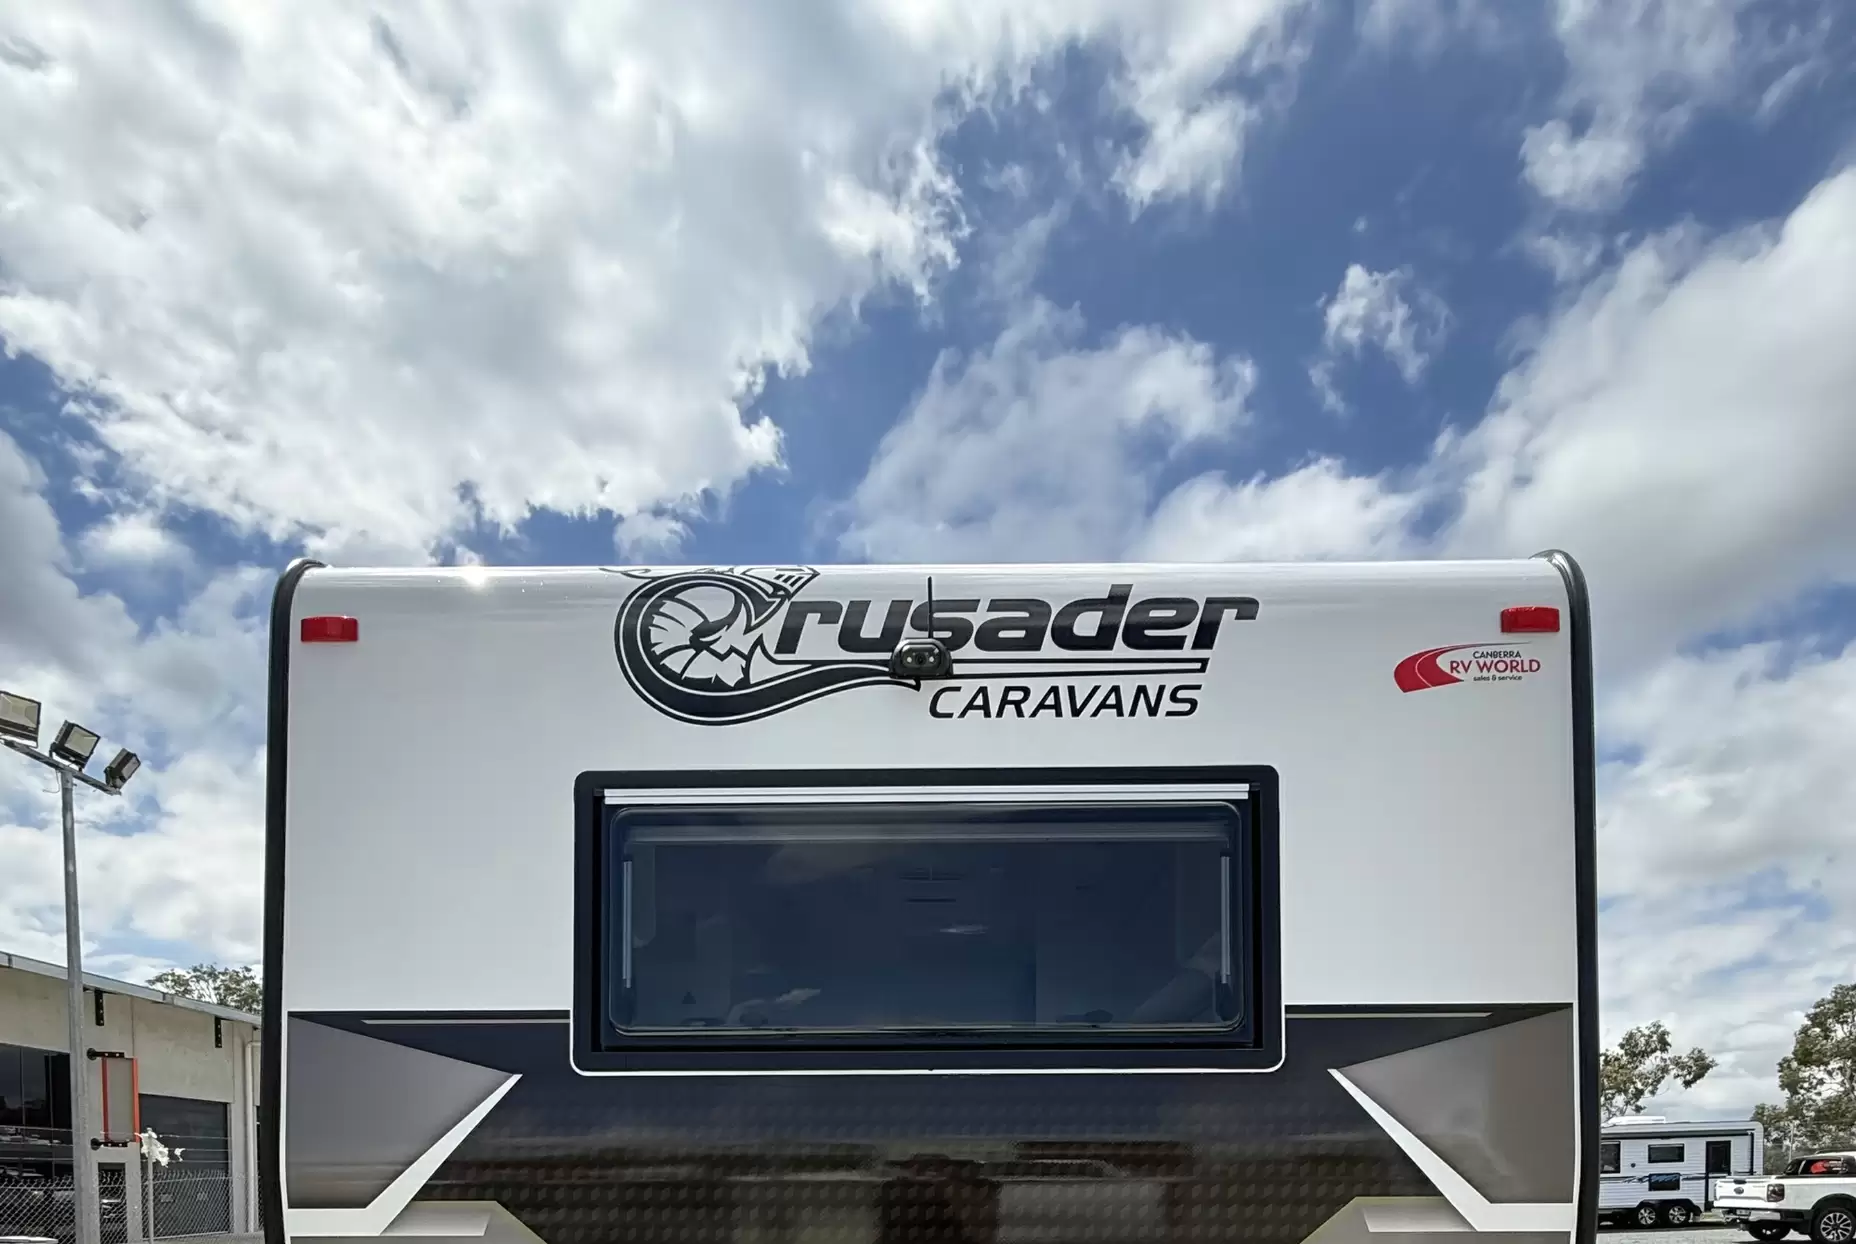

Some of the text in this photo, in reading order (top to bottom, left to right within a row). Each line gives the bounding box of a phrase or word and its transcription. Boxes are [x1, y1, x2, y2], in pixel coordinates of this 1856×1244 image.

[1472, 650, 1522, 659] CANBERRA
[1450, 659, 1541, 674] RV WORLD
[1473, 674, 1490, 682] sales
[1498, 674, 1522, 682] service
[929, 684, 1202, 719] CARAVANS
